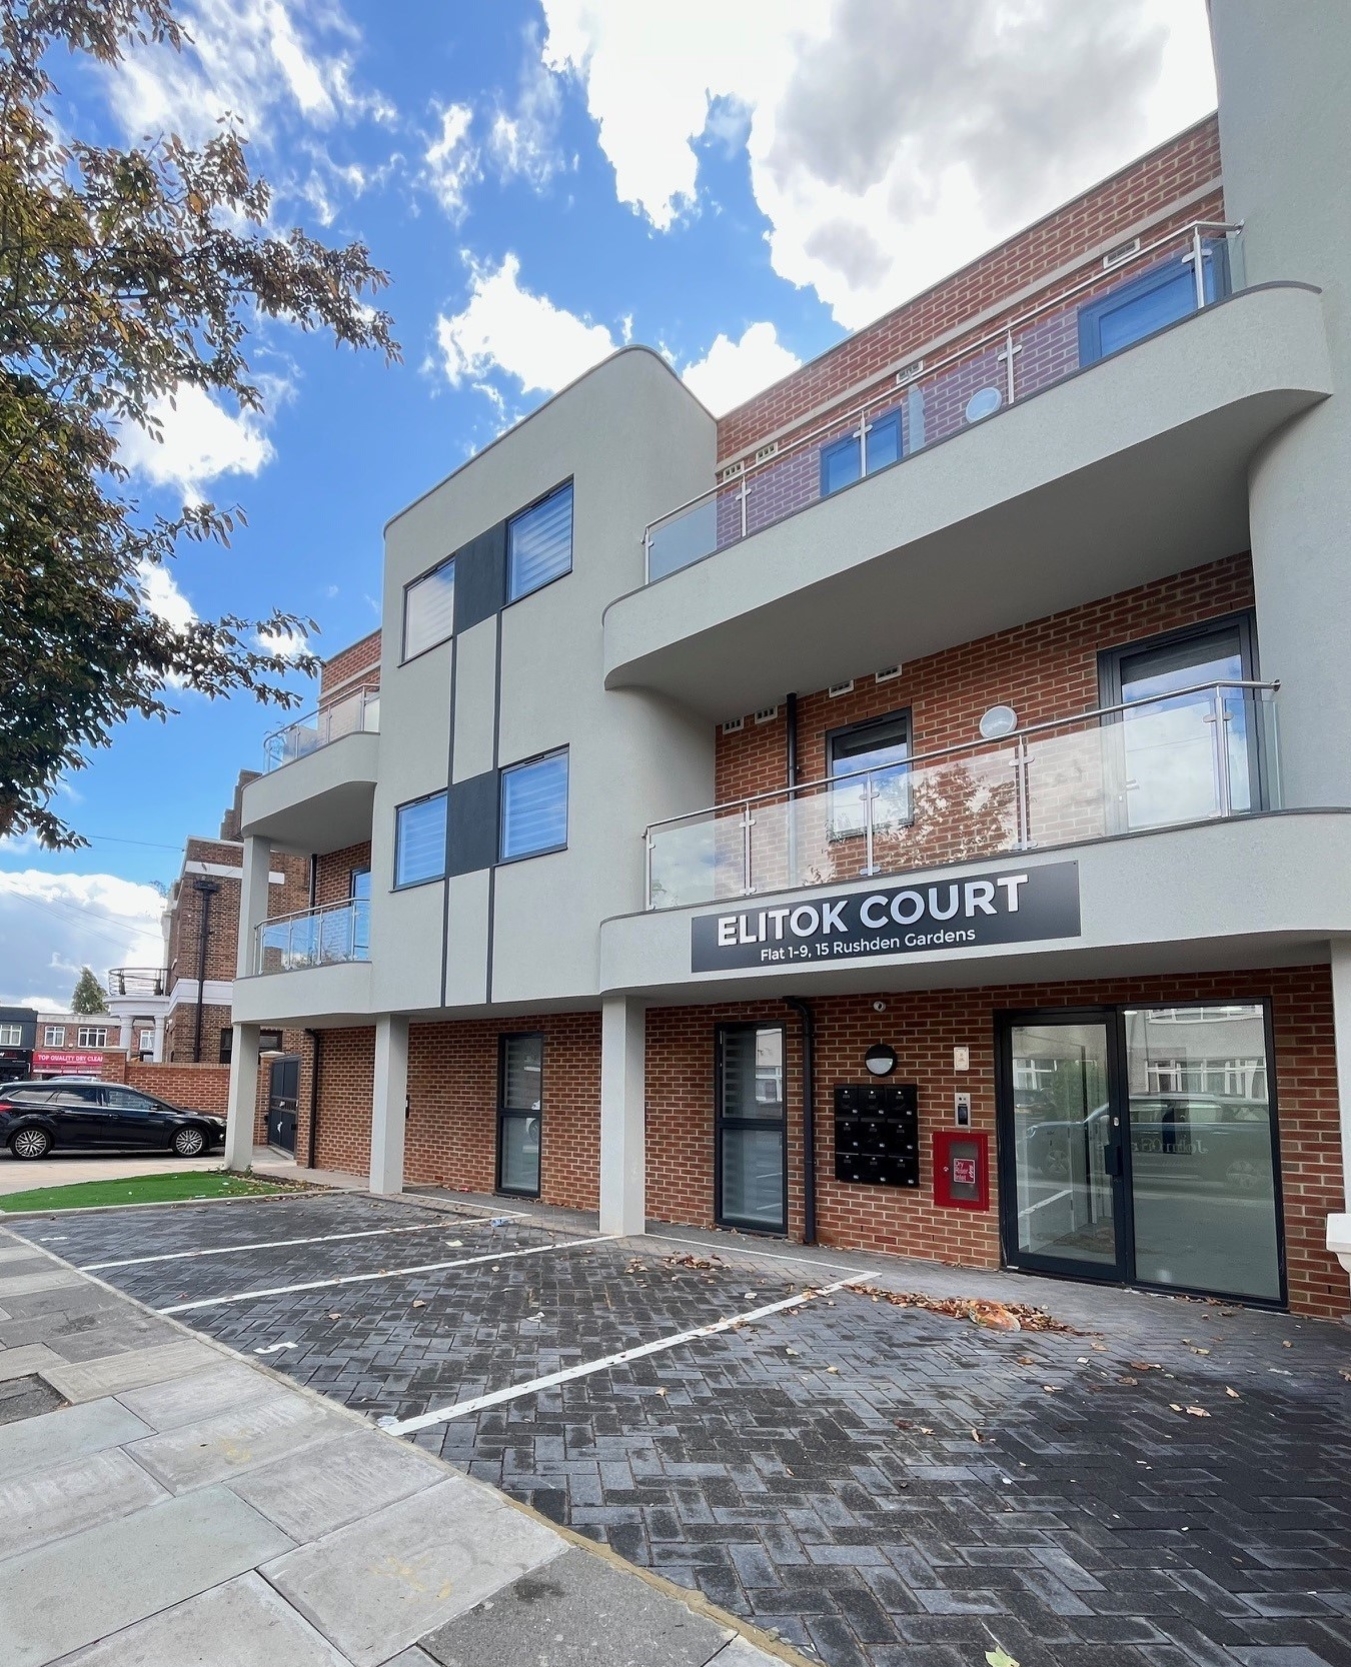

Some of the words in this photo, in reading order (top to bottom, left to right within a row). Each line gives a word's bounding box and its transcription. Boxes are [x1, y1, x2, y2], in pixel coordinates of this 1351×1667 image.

[717, 901, 849, 947] ELITOK
[859, 874, 1029, 929] COURT
[760, 947, 786, 962] Flat
[788, 944, 812, 959] 1-9,
[815, 941, 830, 957] 15
[833, 935, 901, 956] Rushden
[904, 928, 977, 950] Gardens
